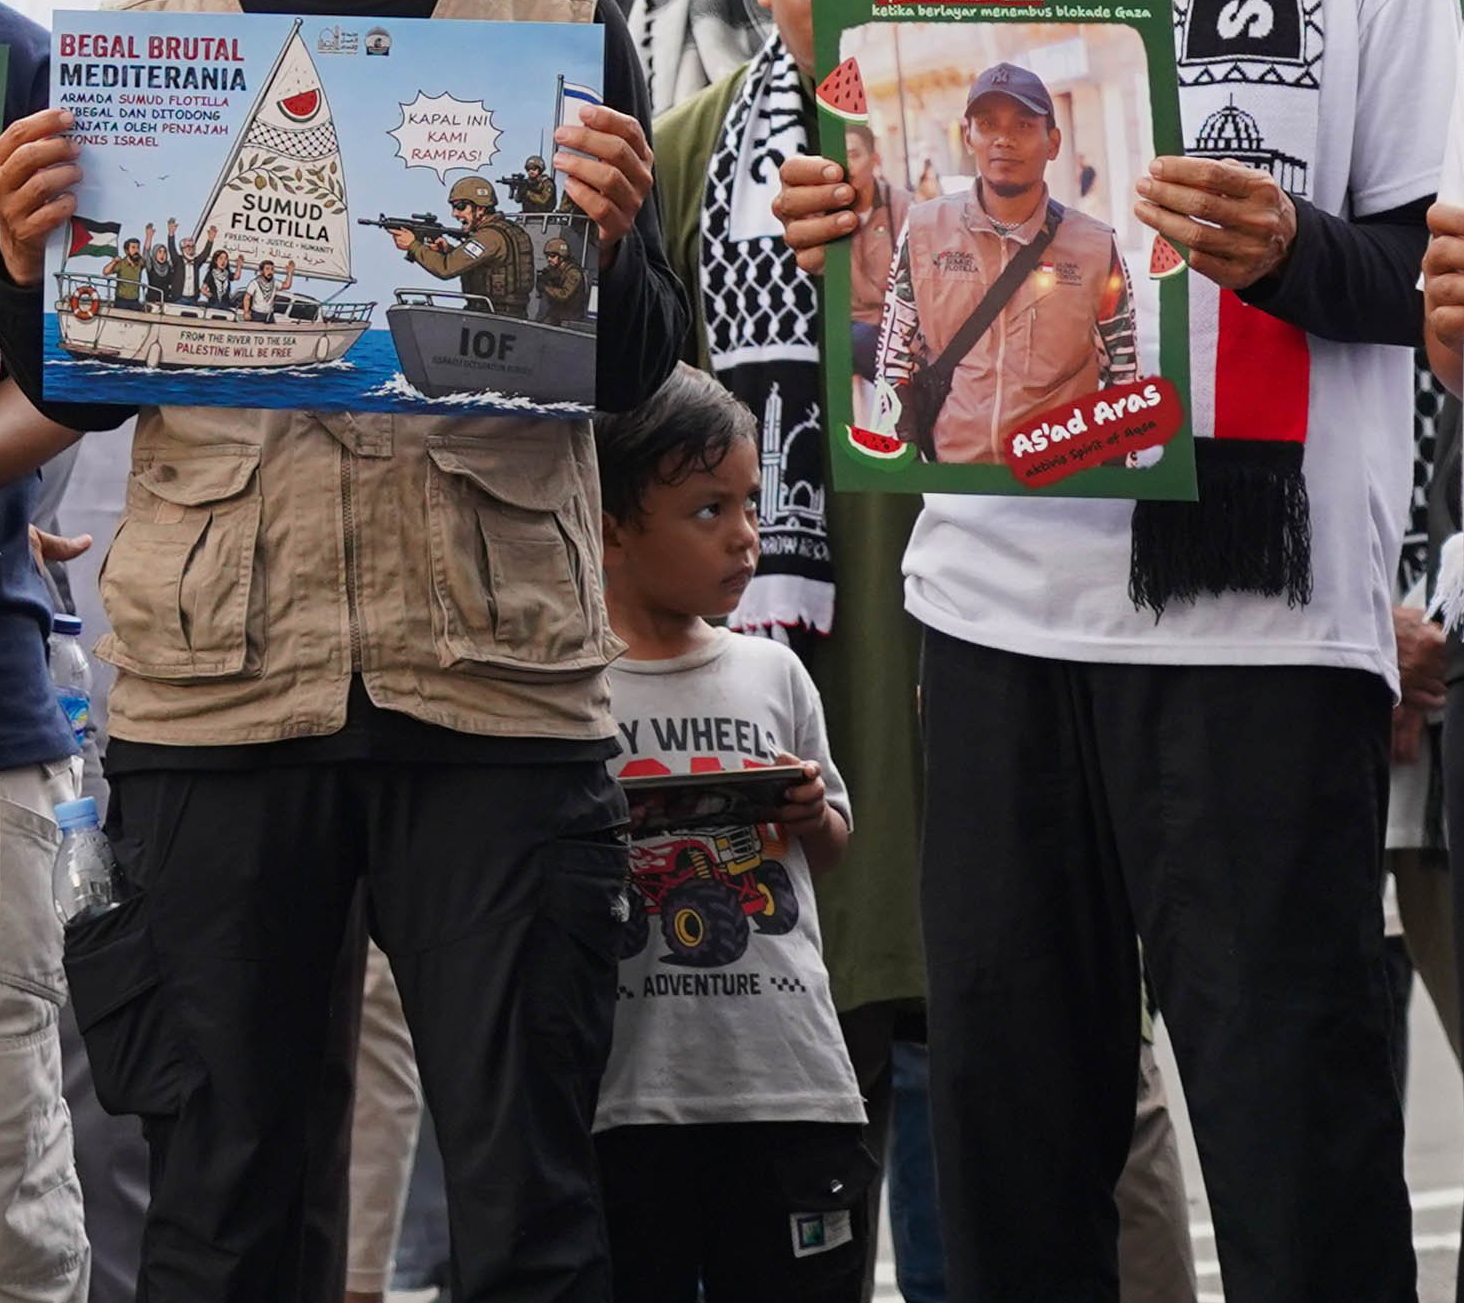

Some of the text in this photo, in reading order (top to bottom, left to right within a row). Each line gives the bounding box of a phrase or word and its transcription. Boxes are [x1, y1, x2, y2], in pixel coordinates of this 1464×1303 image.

[871, 4, 1152, 20] ketika berlayar menembus blokade Gaza
[60, 33, 245, 62] BEGAL BRUTAL
[60, 63, 247, 92] MEDITERANIA
[60, 93, 229, 107] ARMADA SUMUD FLOTILLA
[119, 108, 147, 119] DAN
[150, 109, 221, 120] DITODONG
[408, 113, 488, 126] KAPAL INI
[124, 122, 157, 133] OLEH
[161, 123, 229, 135] PENJAJAH
[114, 135, 159, 147] ISRAEL
[427, 131, 468, 143] KAMI
[411, 148, 482, 162] RAMPAS!
[242, 194, 323, 221] SUMUD
[231, 212, 330, 242] FLOTILLA
[224, 233, 335, 254] FREEDOM JUSTICE HUMANITY
[180, 331, 296, 346] FROM THE RIVER TO THE SEA
[460, 327, 517, 360] IOF
[176, 342, 292, 358] PALESTINE WILL BE FREE
[1012, 384, 1161, 458] As'ad Aras
[1069, 440, 1103, 460] Spirit
[1107, 432, 1120, 444] of
[643, 972, 762, 997] ADVENTURE
